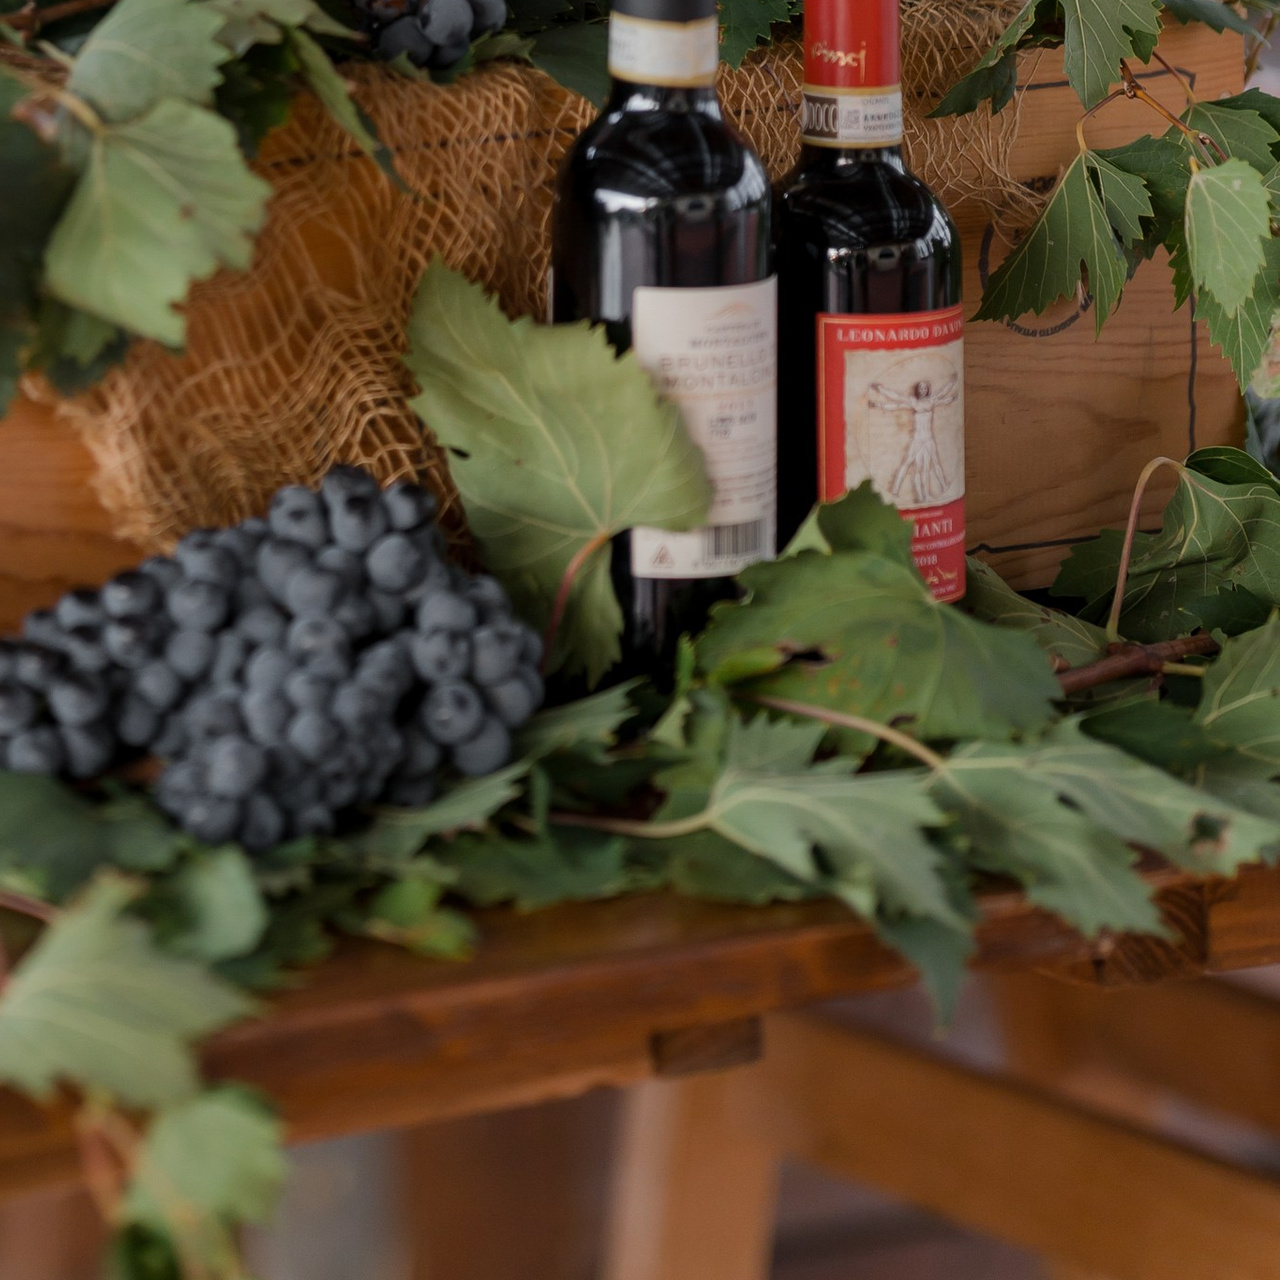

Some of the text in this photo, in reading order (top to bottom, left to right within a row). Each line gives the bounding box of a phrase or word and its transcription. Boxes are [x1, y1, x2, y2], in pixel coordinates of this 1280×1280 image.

[837, 326, 929, 342] LEONARDO
[932, 323, 948, 338] DA
[913, 518, 953, 538] IANTI
